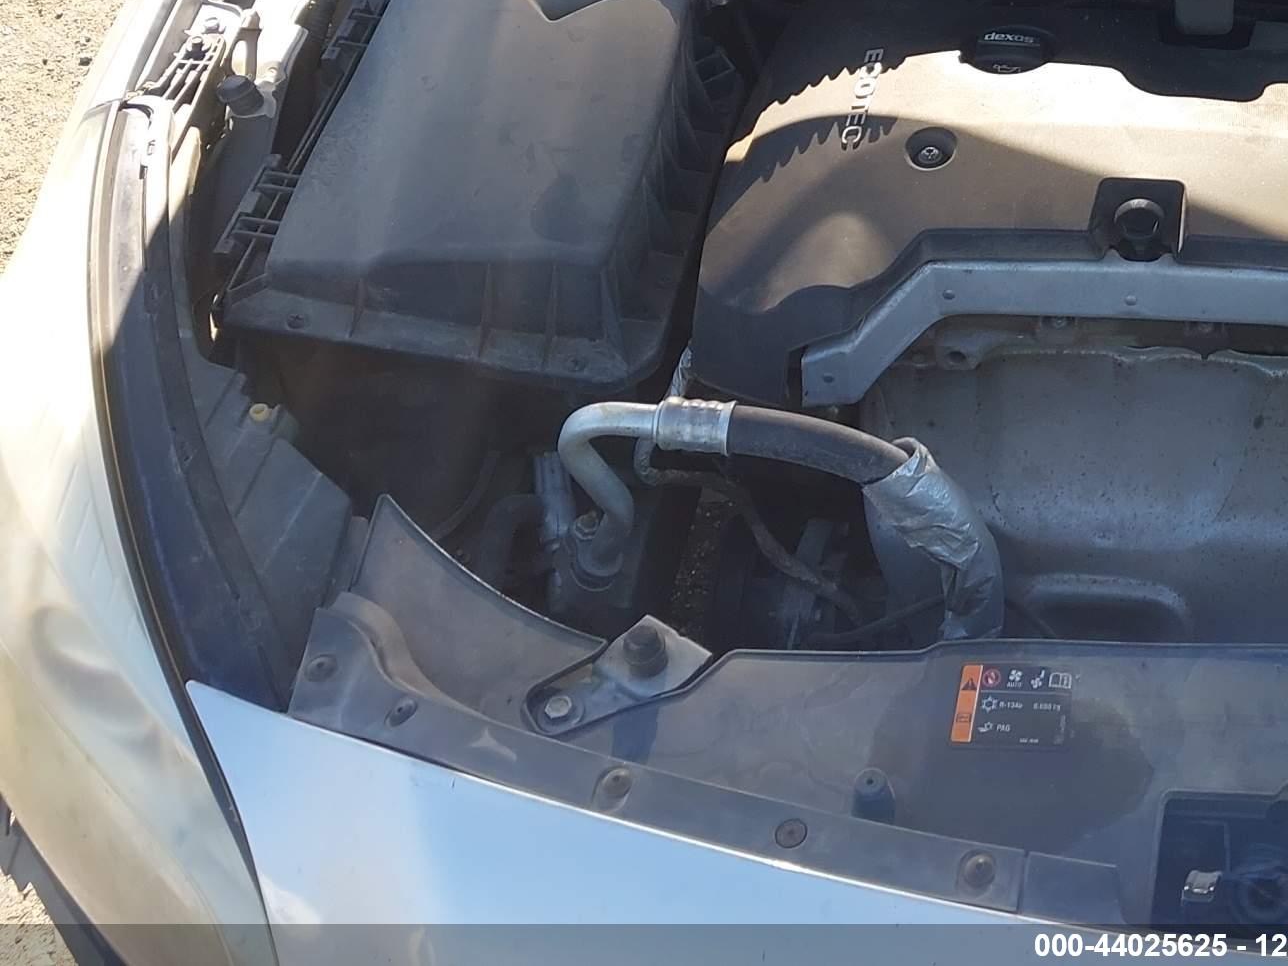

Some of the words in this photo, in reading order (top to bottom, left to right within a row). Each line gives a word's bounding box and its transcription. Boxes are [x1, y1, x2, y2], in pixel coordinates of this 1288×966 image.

[984, 32, 1034, 43] dexos
[841, 49, 884, 147] ECOTEC
[996, 723, 1011, 732] PAG
